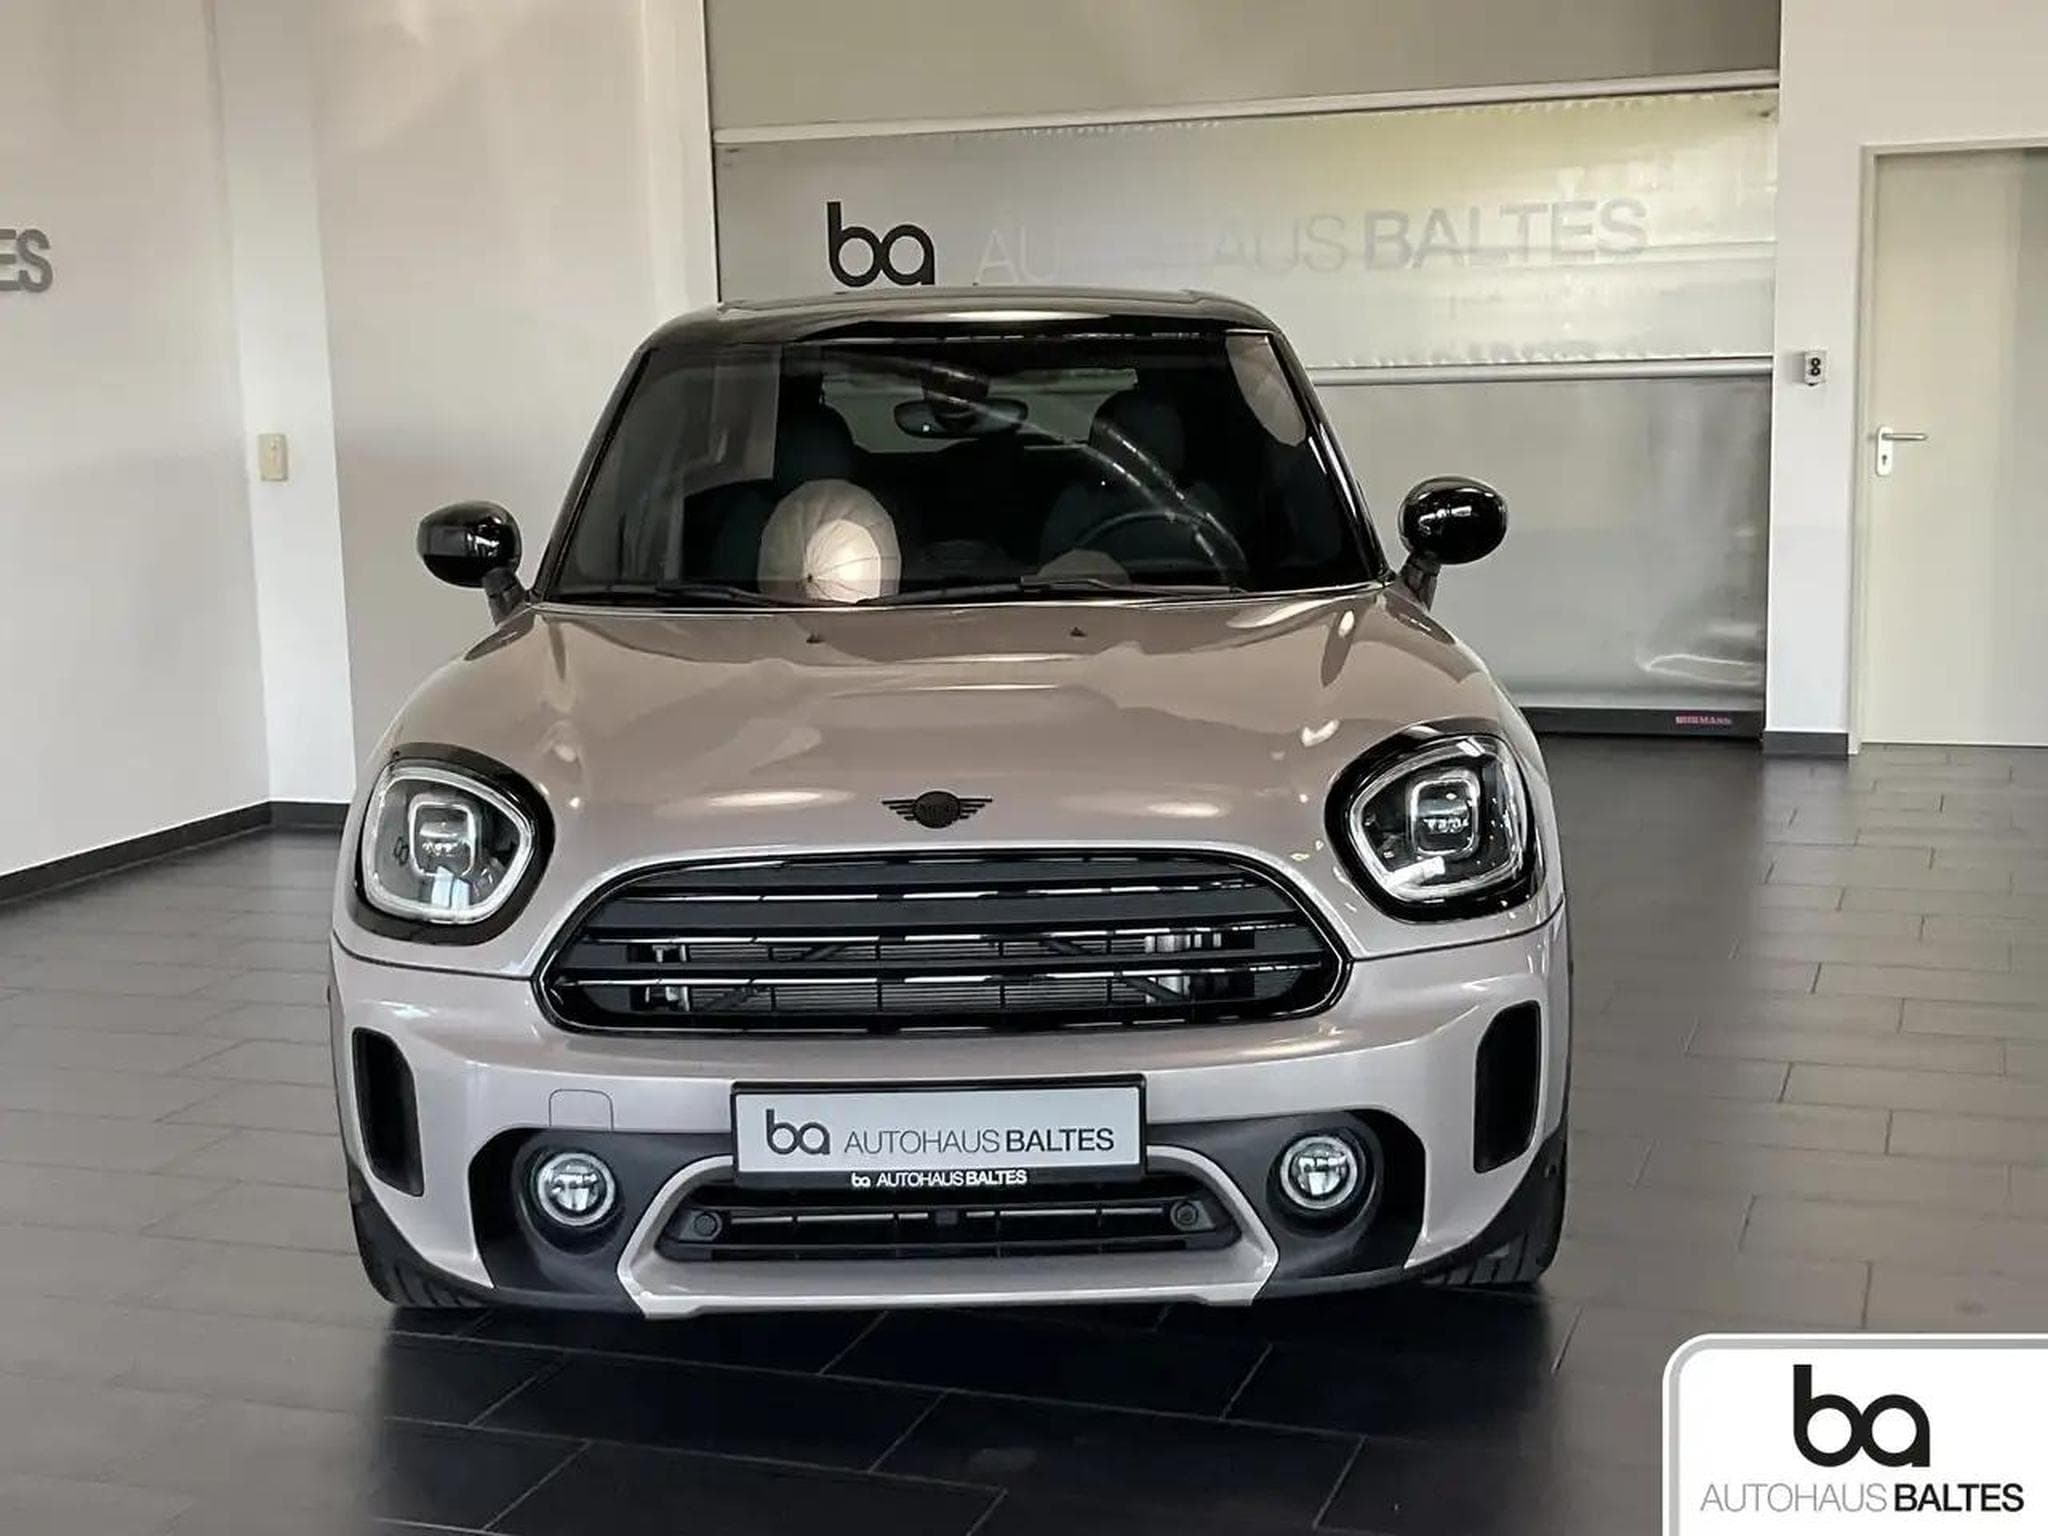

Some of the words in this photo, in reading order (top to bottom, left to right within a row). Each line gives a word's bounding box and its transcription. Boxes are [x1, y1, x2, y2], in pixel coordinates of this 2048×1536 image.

[826, 200, 936, 288] ba
[1363, 197, 1649, 272] BALTES
[765, 1108, 831, 1155] ba
[844, 1129, 1001, 1155] AUTOHAUS
[1005, 1127, 1115, 1152] BALTES
[851, 1172, 871, 1187] ba
[876, 1171, 965, 1187] AUTOHAUS
[966, 1169, 1027, 1186] BALTES
